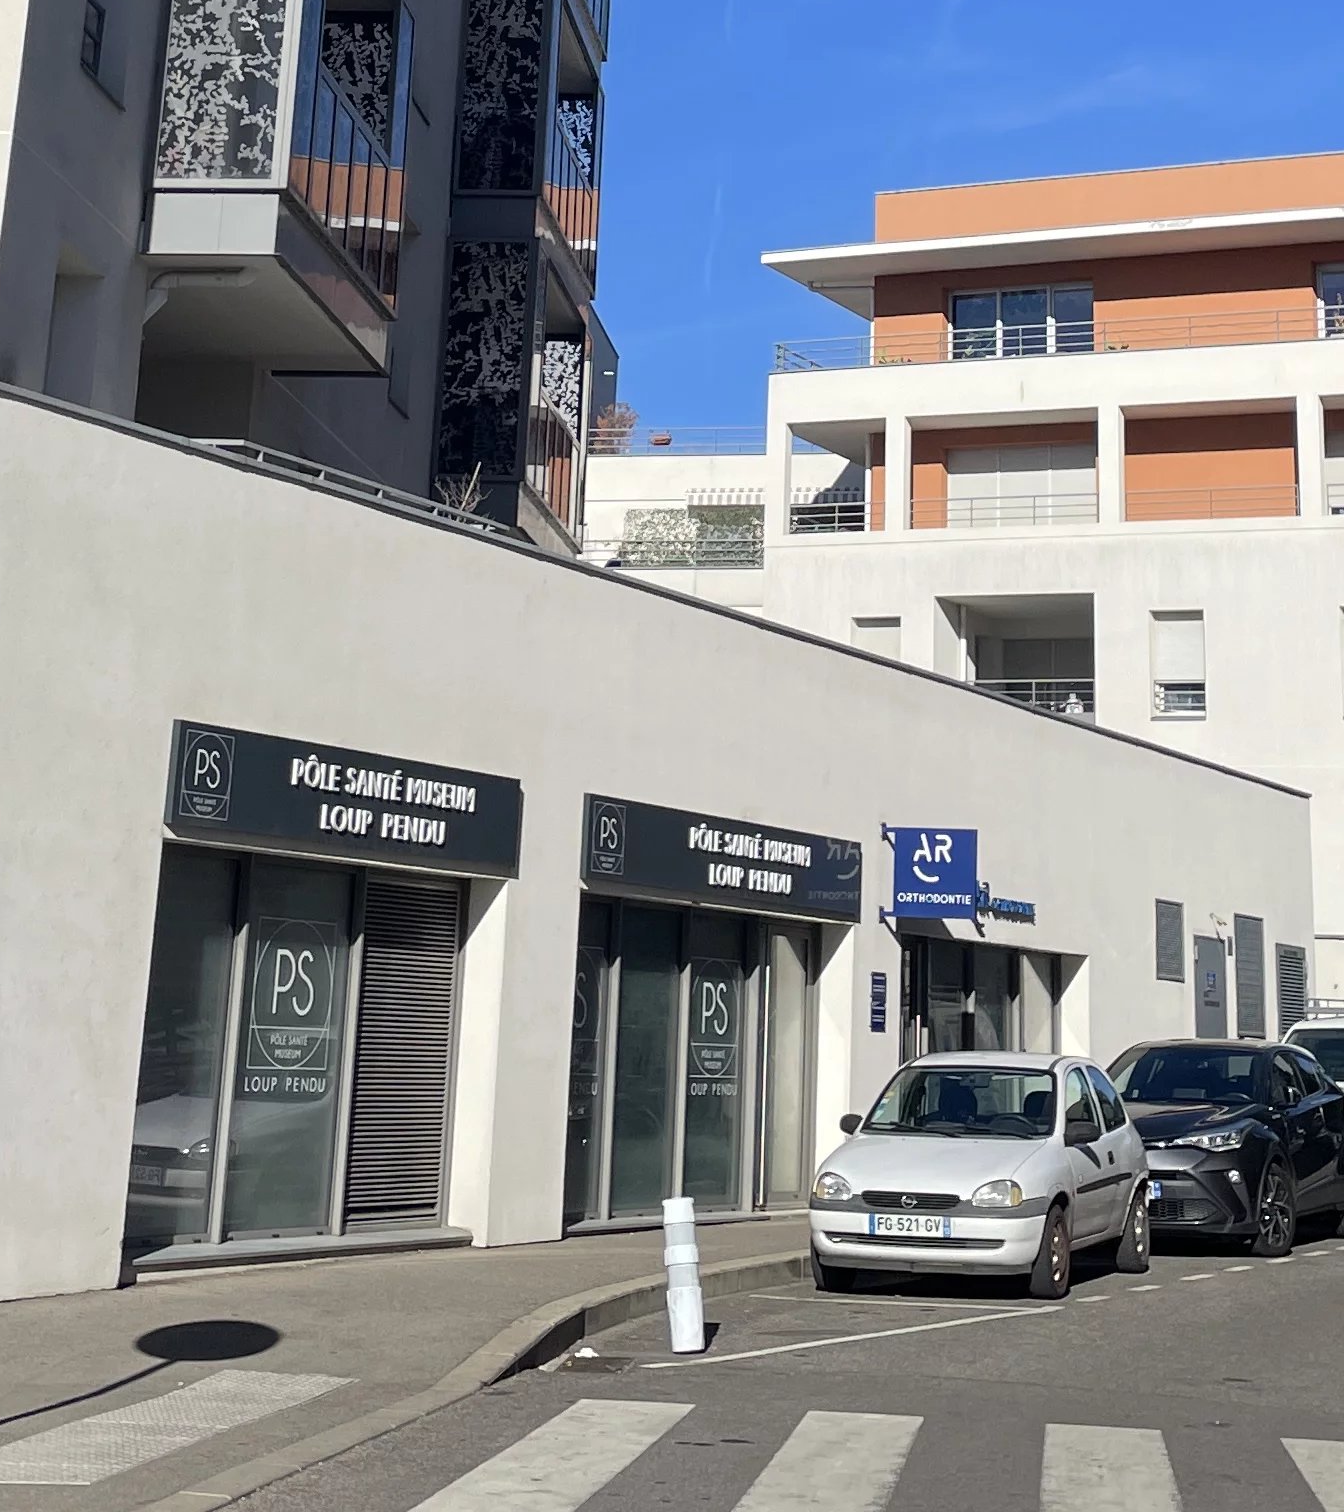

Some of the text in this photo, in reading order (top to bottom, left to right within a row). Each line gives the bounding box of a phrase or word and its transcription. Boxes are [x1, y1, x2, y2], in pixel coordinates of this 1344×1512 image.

[193, 748, 221, 789] PS
[290, 754, 478, 813] PÔLE SANTÉ MUSEUM
[319, 803, 447, 846] LOUP PENDU
[599, 816, 618, 850] PS
[688, 823, 723, 852] PÔLE
[913, 833, 953, 863] AR
[708, 863, 744, 887] LOUP
[748, 868, 792, 896] PENDU
[897, 892, 972, 906] ORTHODONTIE
[271, 948, 315, 1017] PS
[701, 981, 729, 1035] PS
[244, 1076, 326, 1093] LOUP PENDU
[690, 1082, 709, 1096] OUP
